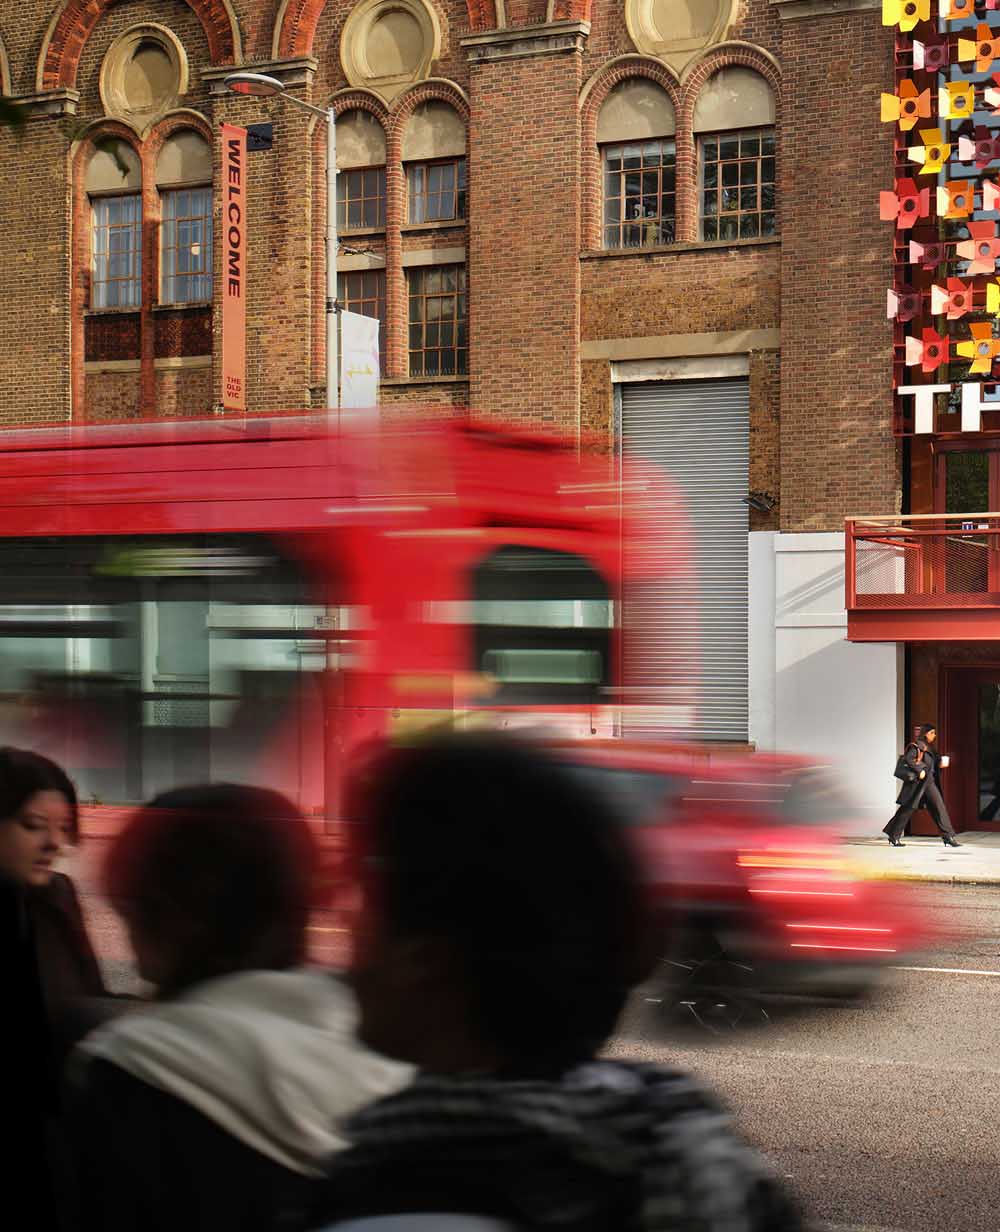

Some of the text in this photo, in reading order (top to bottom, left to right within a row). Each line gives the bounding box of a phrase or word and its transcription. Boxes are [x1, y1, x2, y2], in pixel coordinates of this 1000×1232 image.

[228, 139, 241, 298] WELCOME
[226, 376, 241, 384] THE
[226, 383, 241, 391] OLD
[226, 390, 239, 398] VIC
